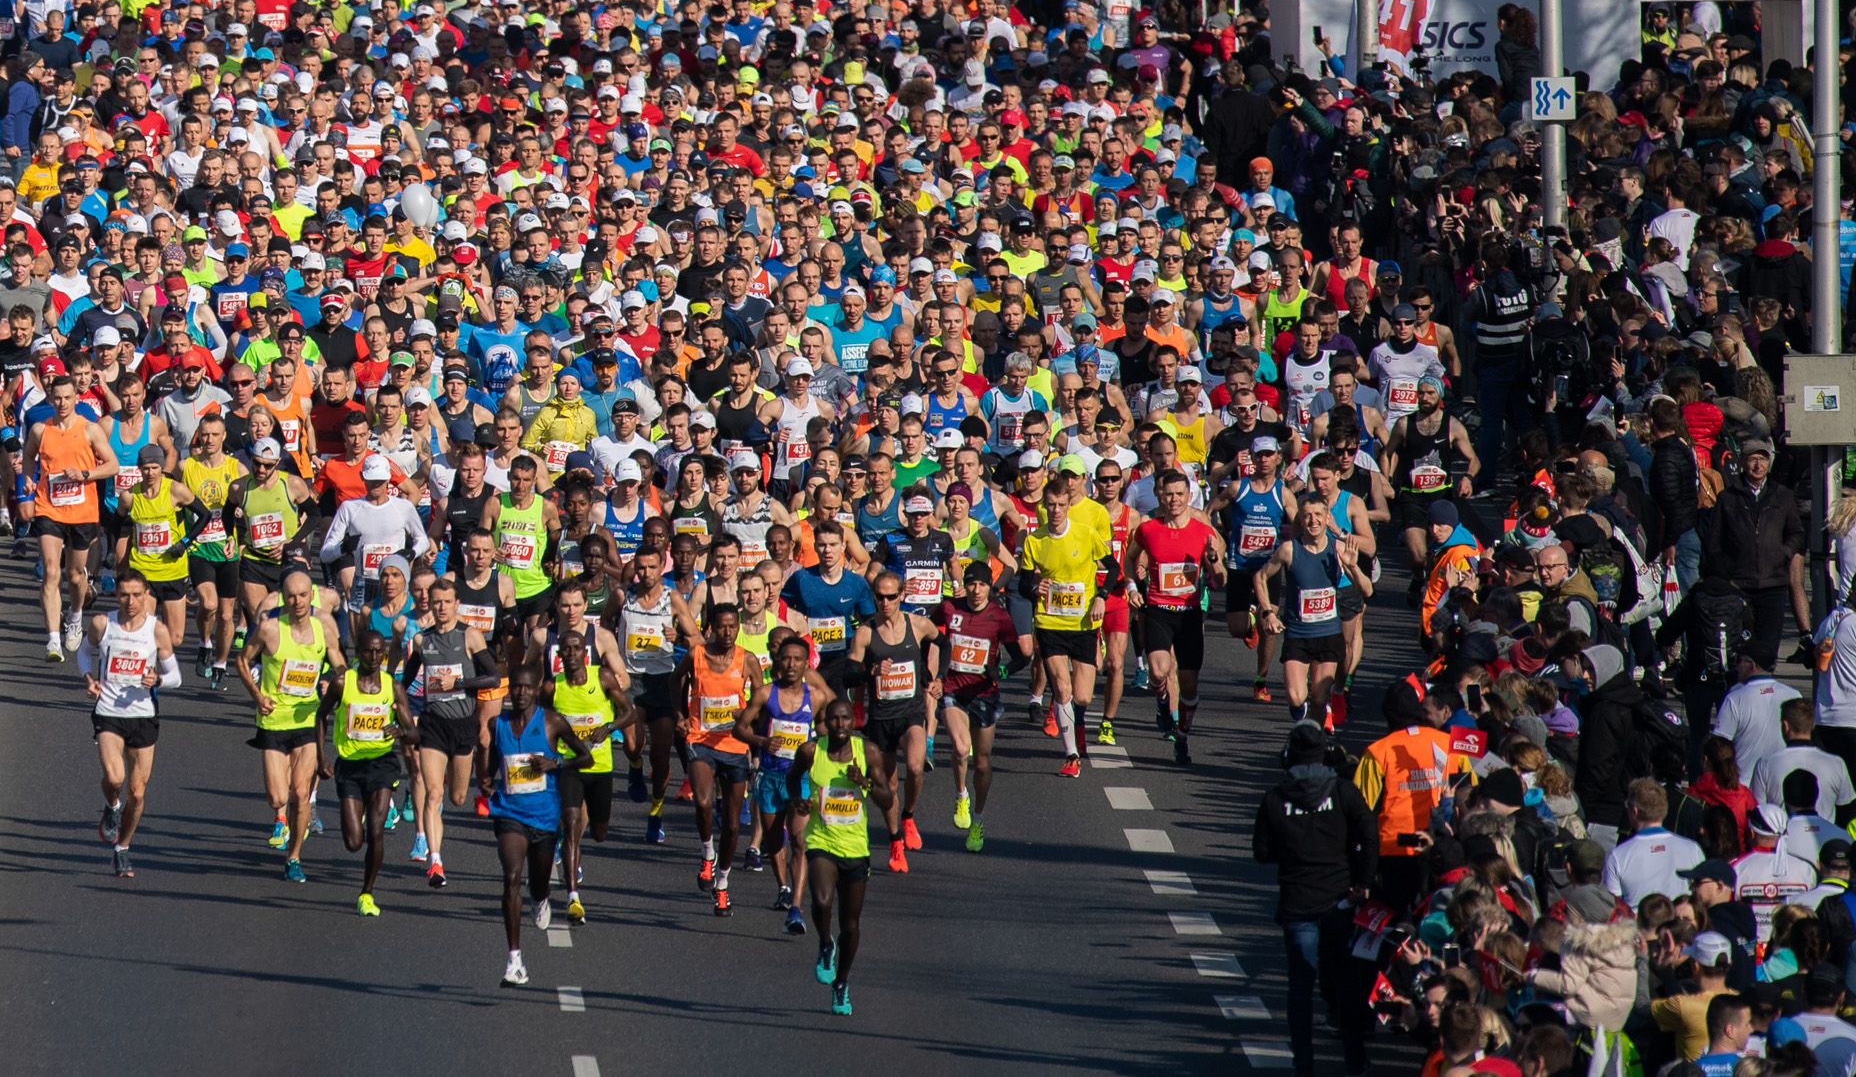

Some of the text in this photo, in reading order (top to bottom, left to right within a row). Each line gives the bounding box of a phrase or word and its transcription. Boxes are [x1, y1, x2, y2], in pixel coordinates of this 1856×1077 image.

[1395, 391, 1415, 400] 3973
[255, 523, 278, 536] 1062
[142, 531, 164, 543] 5961
[1247, 536, 1269, 546] 5427
[1174, 575, 1186, 586] 61
[1051, 594, 1081, 606] PACE 4
[1308, 597, 1331, 609] 5389
[811, 630, 843, 642] PACE 3
[960, 649, 976, 662] 62
[115, 659, 142, 670] 3804
[882, 677, 912, 688] NOWAK
[354, 716, 384, 729] PACE 2
[825, 803, 859, 812] OMULLO
